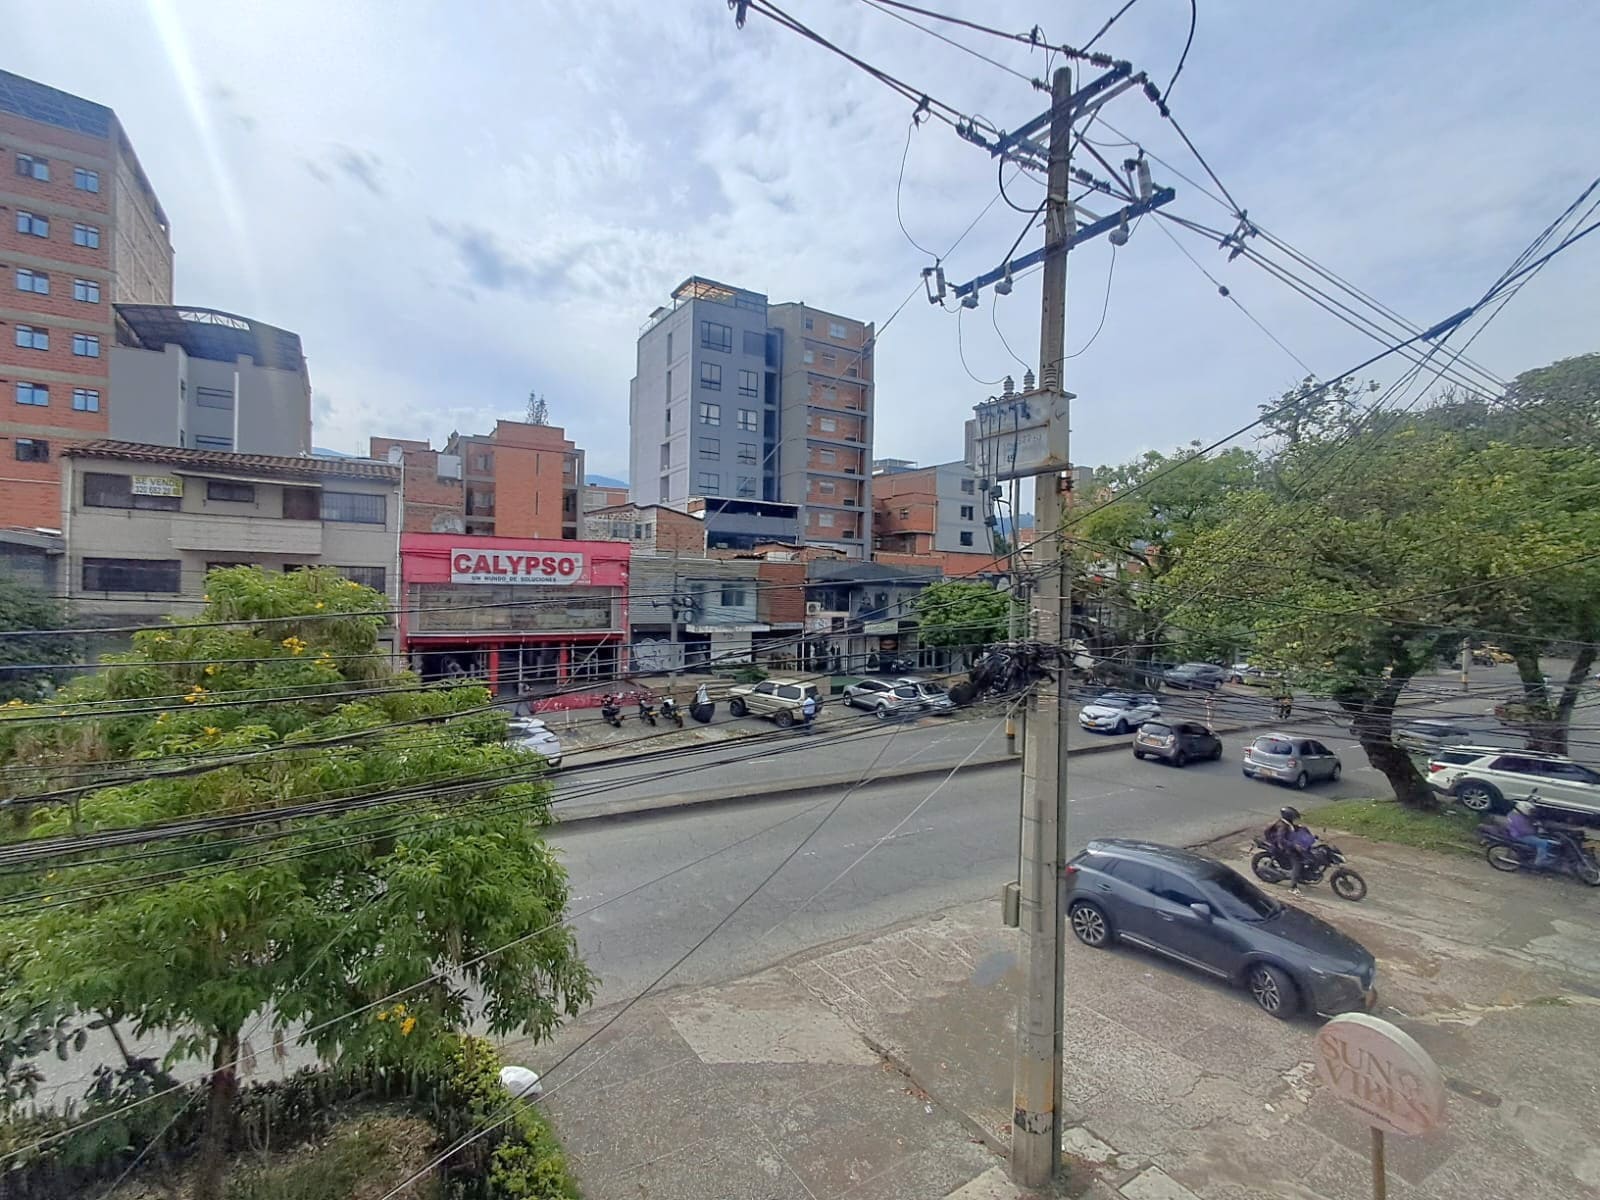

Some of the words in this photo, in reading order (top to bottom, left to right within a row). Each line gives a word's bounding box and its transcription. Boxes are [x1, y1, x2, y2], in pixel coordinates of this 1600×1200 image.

[135, 477, 147, 485] SE
[453, 554, 576, 576] CALYPSO
[1319, 1032, 1393, 1087] SUN
[1323, 1056, 1433, 1129] VIBES
